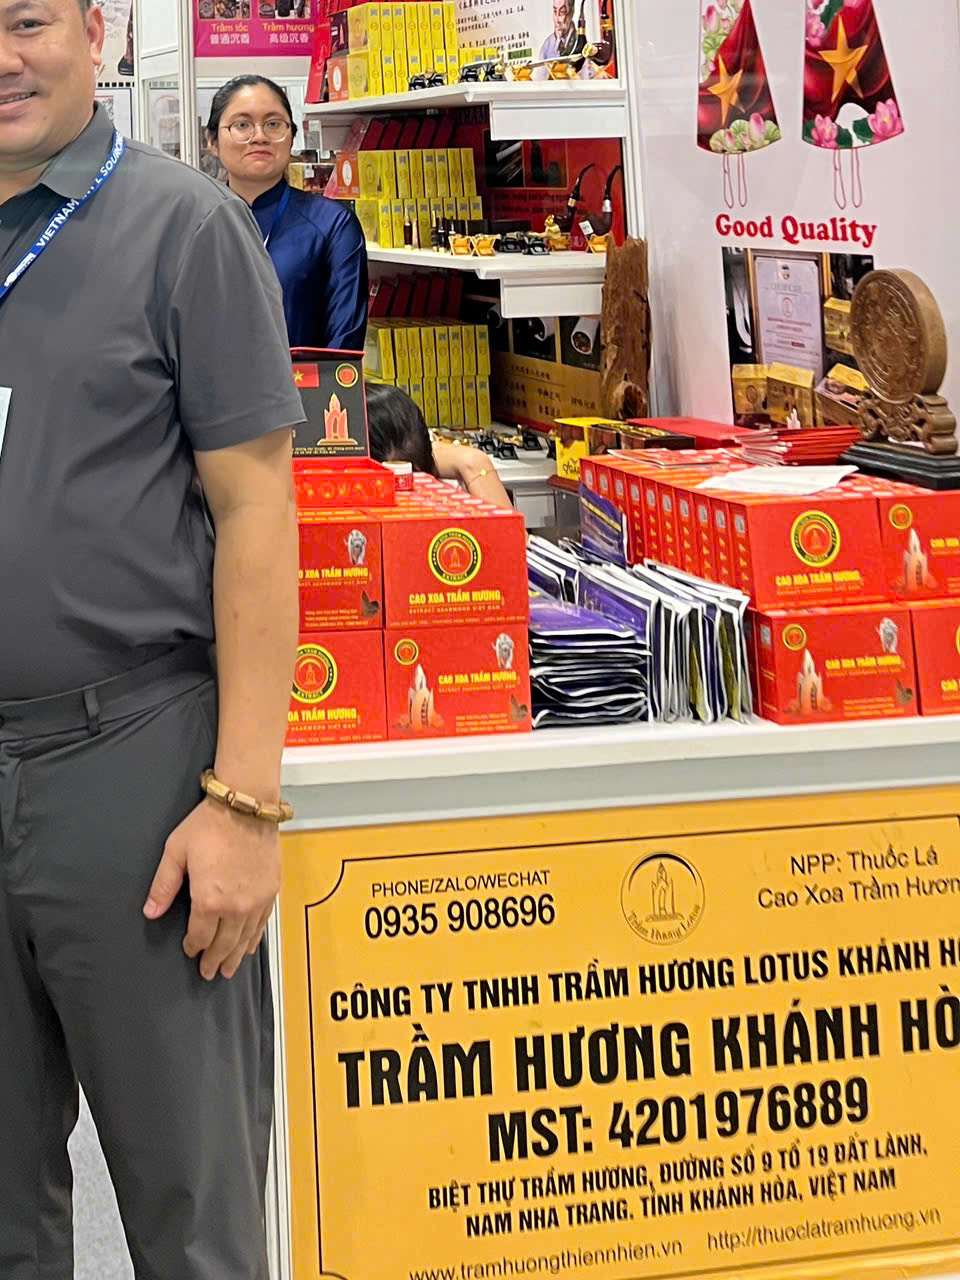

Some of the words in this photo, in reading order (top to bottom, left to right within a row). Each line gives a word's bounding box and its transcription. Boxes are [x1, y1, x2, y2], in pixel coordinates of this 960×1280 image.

[36, 198, 80, 248] VIETNAM
[715, 214, 774, 239] Good
[781, 215, 878, 249] Quality
[409, 593, 426, 605] CAO
[428, 592, 445, 604] XOA
[371, 869, 551, 899] PHONE/ZALO/WECHAT
[790, 852, 842, 877] NPP:
[364, 902, 439, 939] 0935
[447, 893, 556, 933] 908696
[758, 887, 799, 910] Cao
[804, 883, 845, 906] Xoa
[849, 875, 900, 902] Trầm
[330, 982, 412, 1022] CÔNG
[420, 982, 453, 1015] TY
[463, 975, 540, 1011] TNHH
[548, 958, 630, 1003] TRẦM
[638, 957, 735, 995] HƯƠNG
[743, 949, 829, 985] LOTUS
[838, 937, 931, 977] KHÁNH
[337, 1023, 493, 1109] TRẦM
[515, 1020, 692, 1093] HƯƠNG
[712, 999, 881, 1073] KHÁNH
[900, 984, 960, 1054] HÒ
[488, 1103, 593, 1163] MST:
[608, 1076, 869, 1149] 4201976889
[428, 1179, 473, 1213] BIỆT
[477, 1175, 516, 1207] THỰ
[582, 1162, 654, 1192] HƯƠNG,
[659, 1153, 725, 1184] ĐƯỜNG
[731, 1143, 756, 1176] SỐ
[761, 1150, 773, 1172] 9
[808, 1144, 829, 1167] 19
[834, 1133, 869, 1165] ĐẤT
[466, 1211, 513, 1238] NAM
[519, 1207, 559, 1234] NHA
[565, 1198, 634, 1227] TRANG.
[690, 1180, 755, 1213] KHÁNH
[761, 1174, 803, 1204] HÒA,
[807, 1171, 847, 1203] VIỆT
[854, 1167, 897, 1193] NAM
